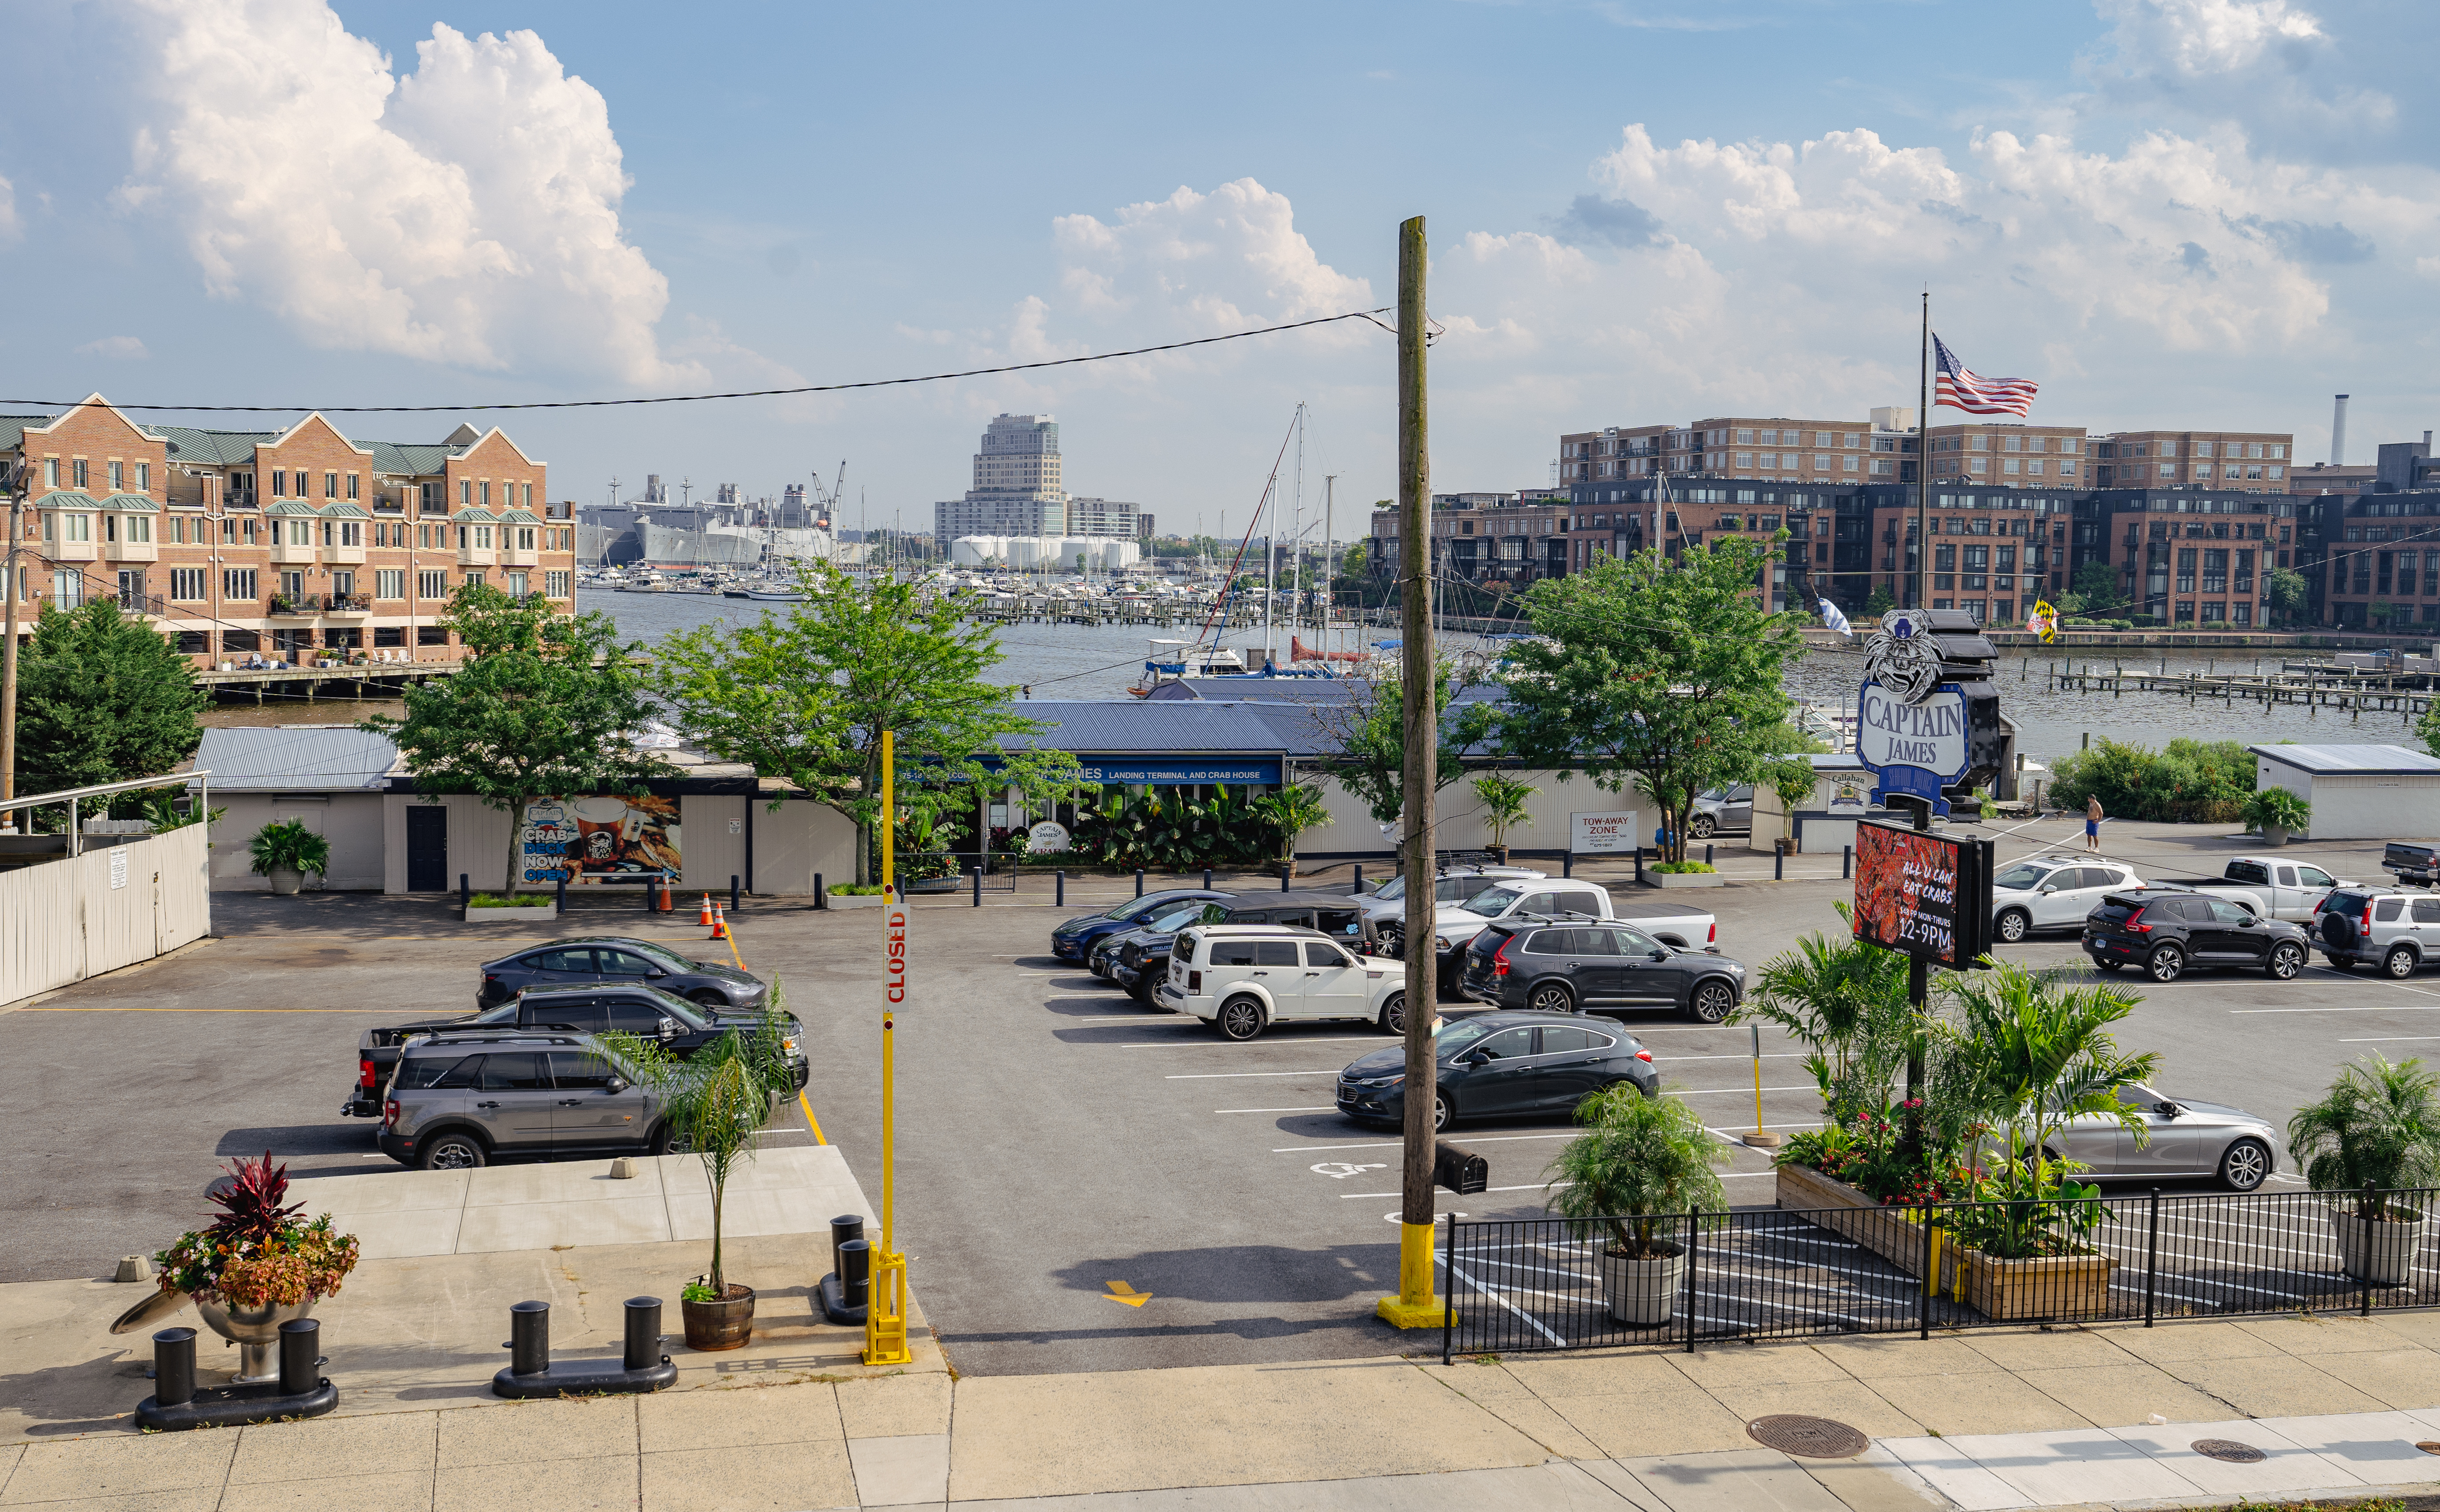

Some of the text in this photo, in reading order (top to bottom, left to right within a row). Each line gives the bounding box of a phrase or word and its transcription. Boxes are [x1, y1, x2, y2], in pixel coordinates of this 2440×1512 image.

[1865, 696, 1961, 737] CAPTAIN
[1885, 737, 1936, 764] JAMES
[1058, 768, 1102, 779] AMES
[1832, 774, 1865, 784] Callahan
[1888, 768, 1934, 793] SEAFOOD PALACE
[1582, 816, 1629, 826] TOW-AWAY
[525, 829, 568, 841] CRAB
[1036, 826, 1062, 836] CAPTAIN
[1589, 826, 1618, 834] ZONE
[525, 843, 567, 854] DECK
[525, 856, 564, 868] NOW
[525, 869, 568, 881] OPEN
[1903, 861, 1954, 884] ALL U CAN
[1903, 879, 1953, 904] EAT CRABS
[1911, 909, 1917, 918] PP
[1918, 911, 1950, 927] MON-THURS
[1900, 917, 1950, 950] 12-9PM
[888, 911, 905, 1003] CLOSED
